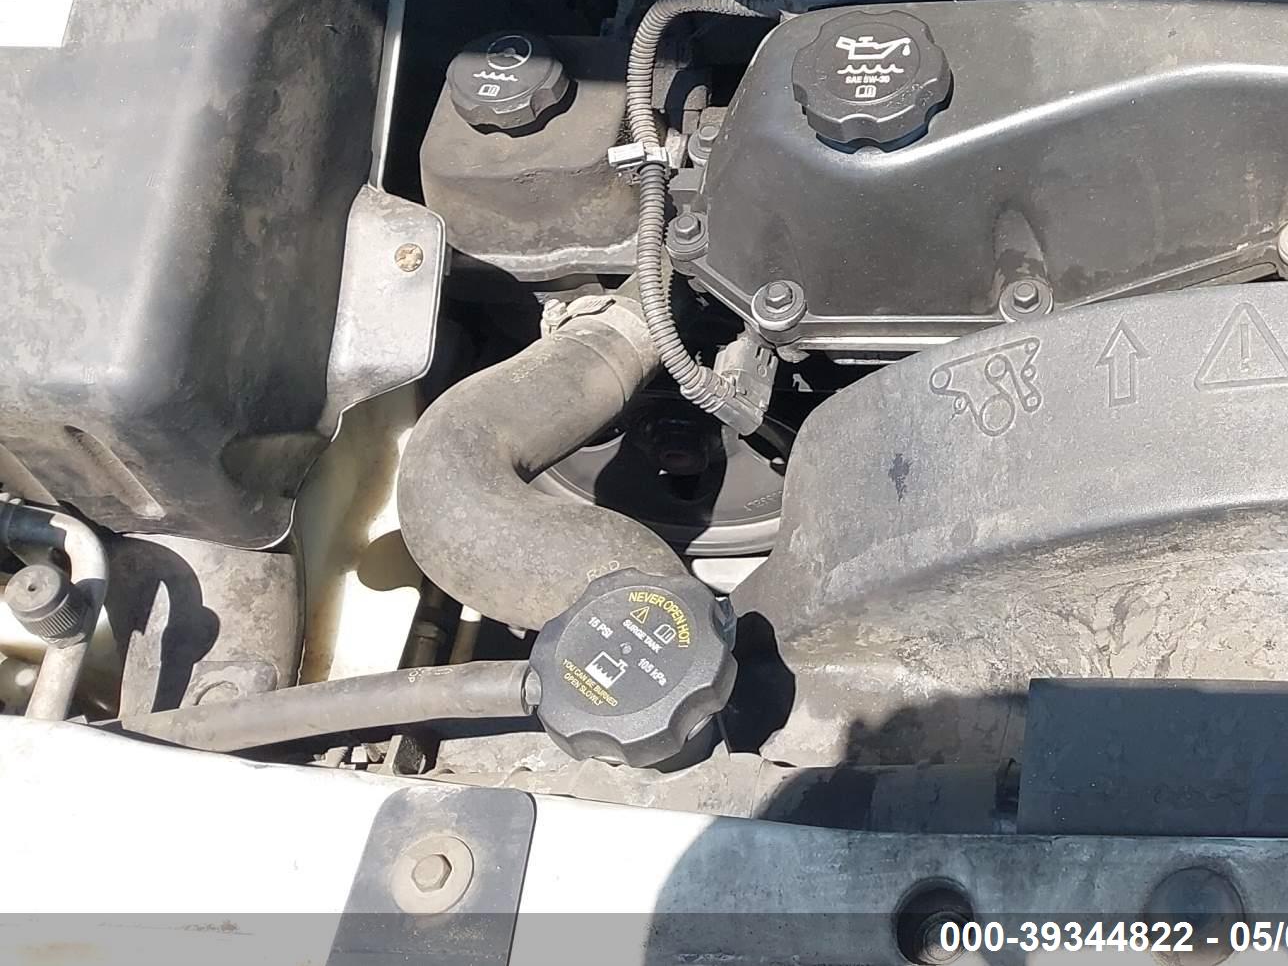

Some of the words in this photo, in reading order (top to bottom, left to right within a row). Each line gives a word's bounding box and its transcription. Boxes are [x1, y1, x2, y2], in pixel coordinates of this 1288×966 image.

[628, 591, 666, 607] NEVER
[663, 600, 687, 625] OPEN
[587, 616, 600, 627] 15
[596, 623, 613, 639] PSI
[622, 619, 647, 641] SURGE
[643, 635, 663, 654] TANK
[562, 658, 577, 672] YOU
[574, 669, 588, 682] CAN
[593, 685, 618, 707] BURNED
[563, 672, 580, 689] OPEN
[579, 684, 604, 706] SLOWLY
[637, 657, 654, 675] 105
[650, 670, 667, 687] kPa
